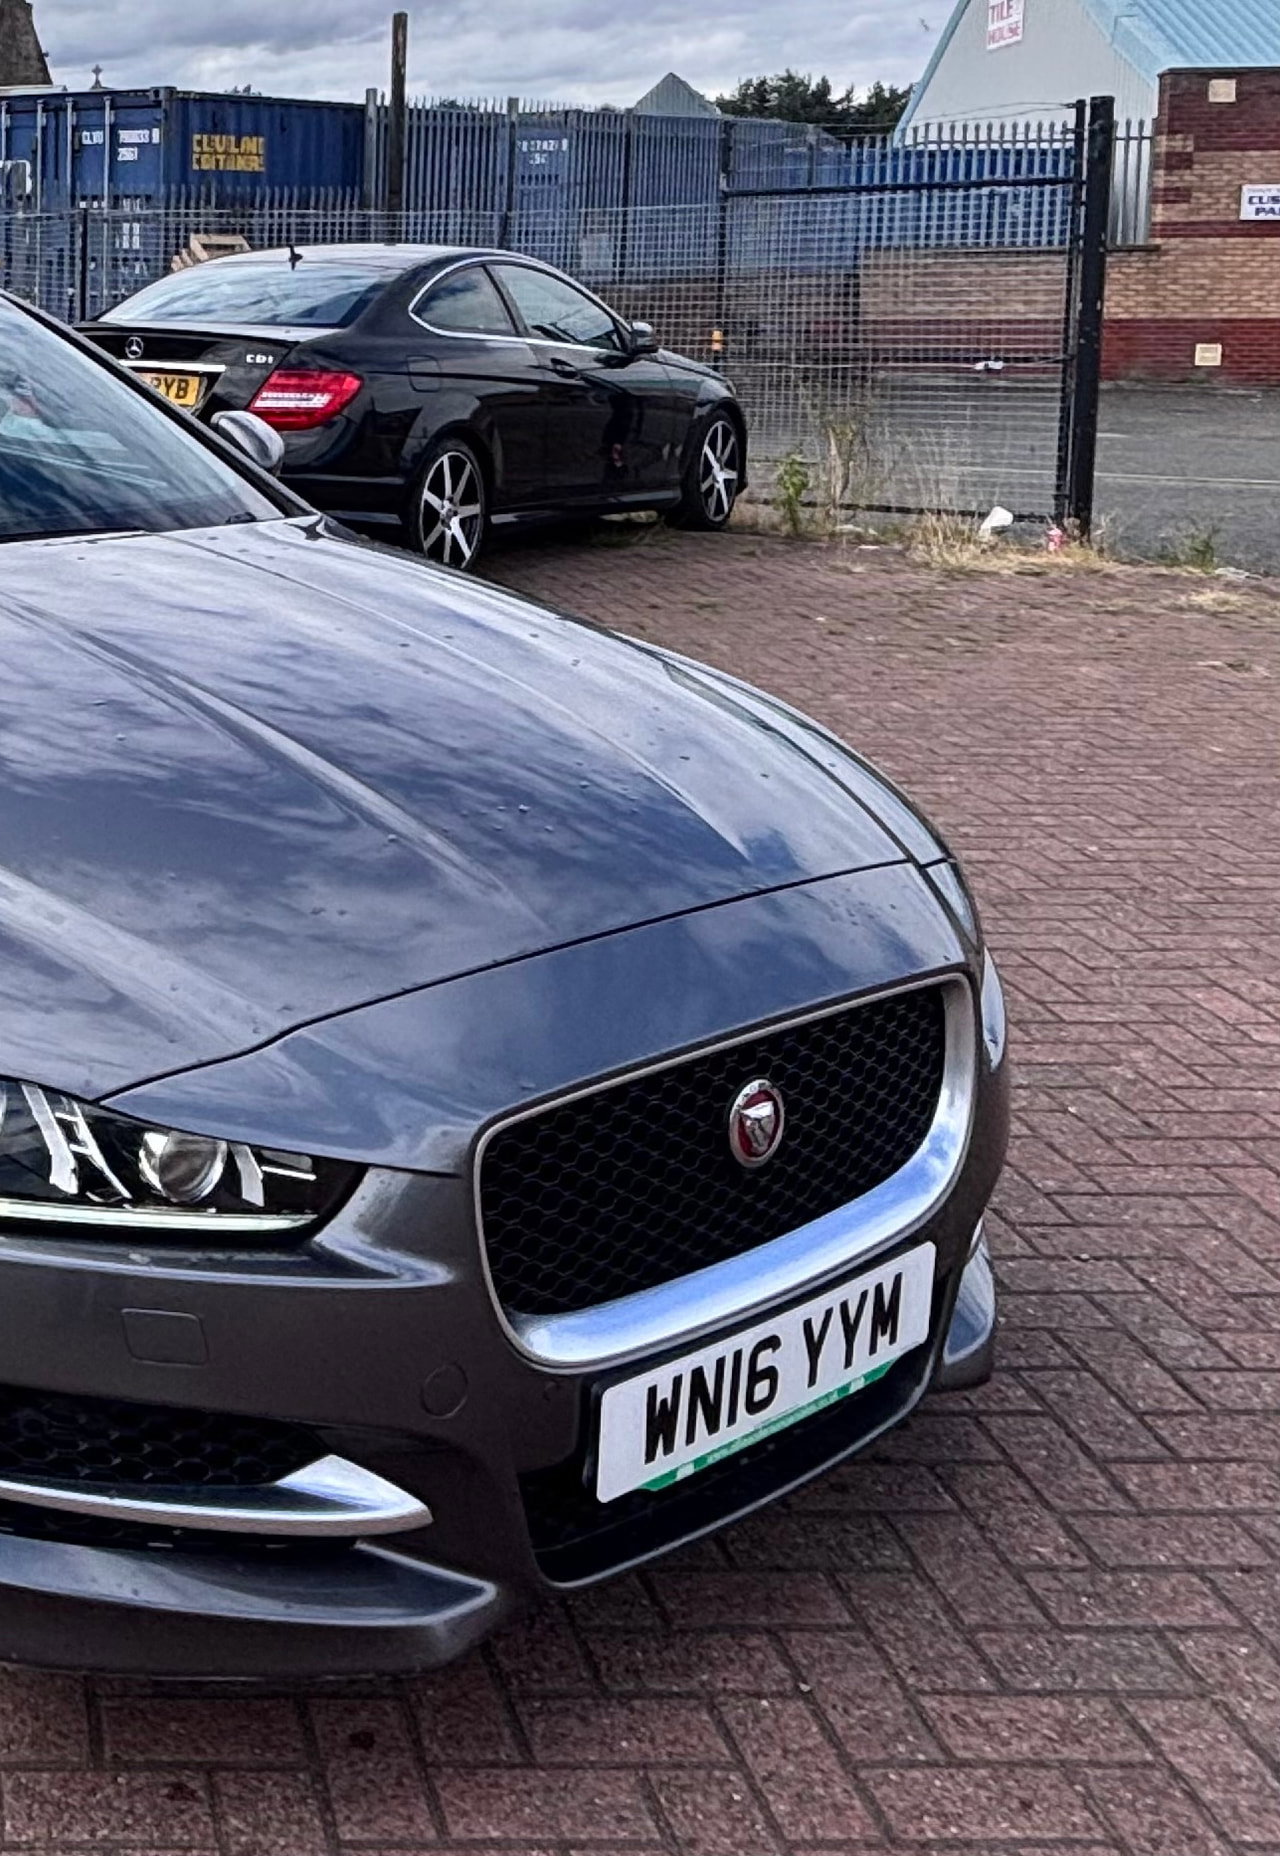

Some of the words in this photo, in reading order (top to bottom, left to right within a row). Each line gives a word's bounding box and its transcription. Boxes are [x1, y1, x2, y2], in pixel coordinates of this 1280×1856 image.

[989, 0, 1013, 24] TILE
[1254, 207, 1280, 217] PA
[643, 1333, 782, 1466] WN16
[802, 1271, 903, 1389] YYM
